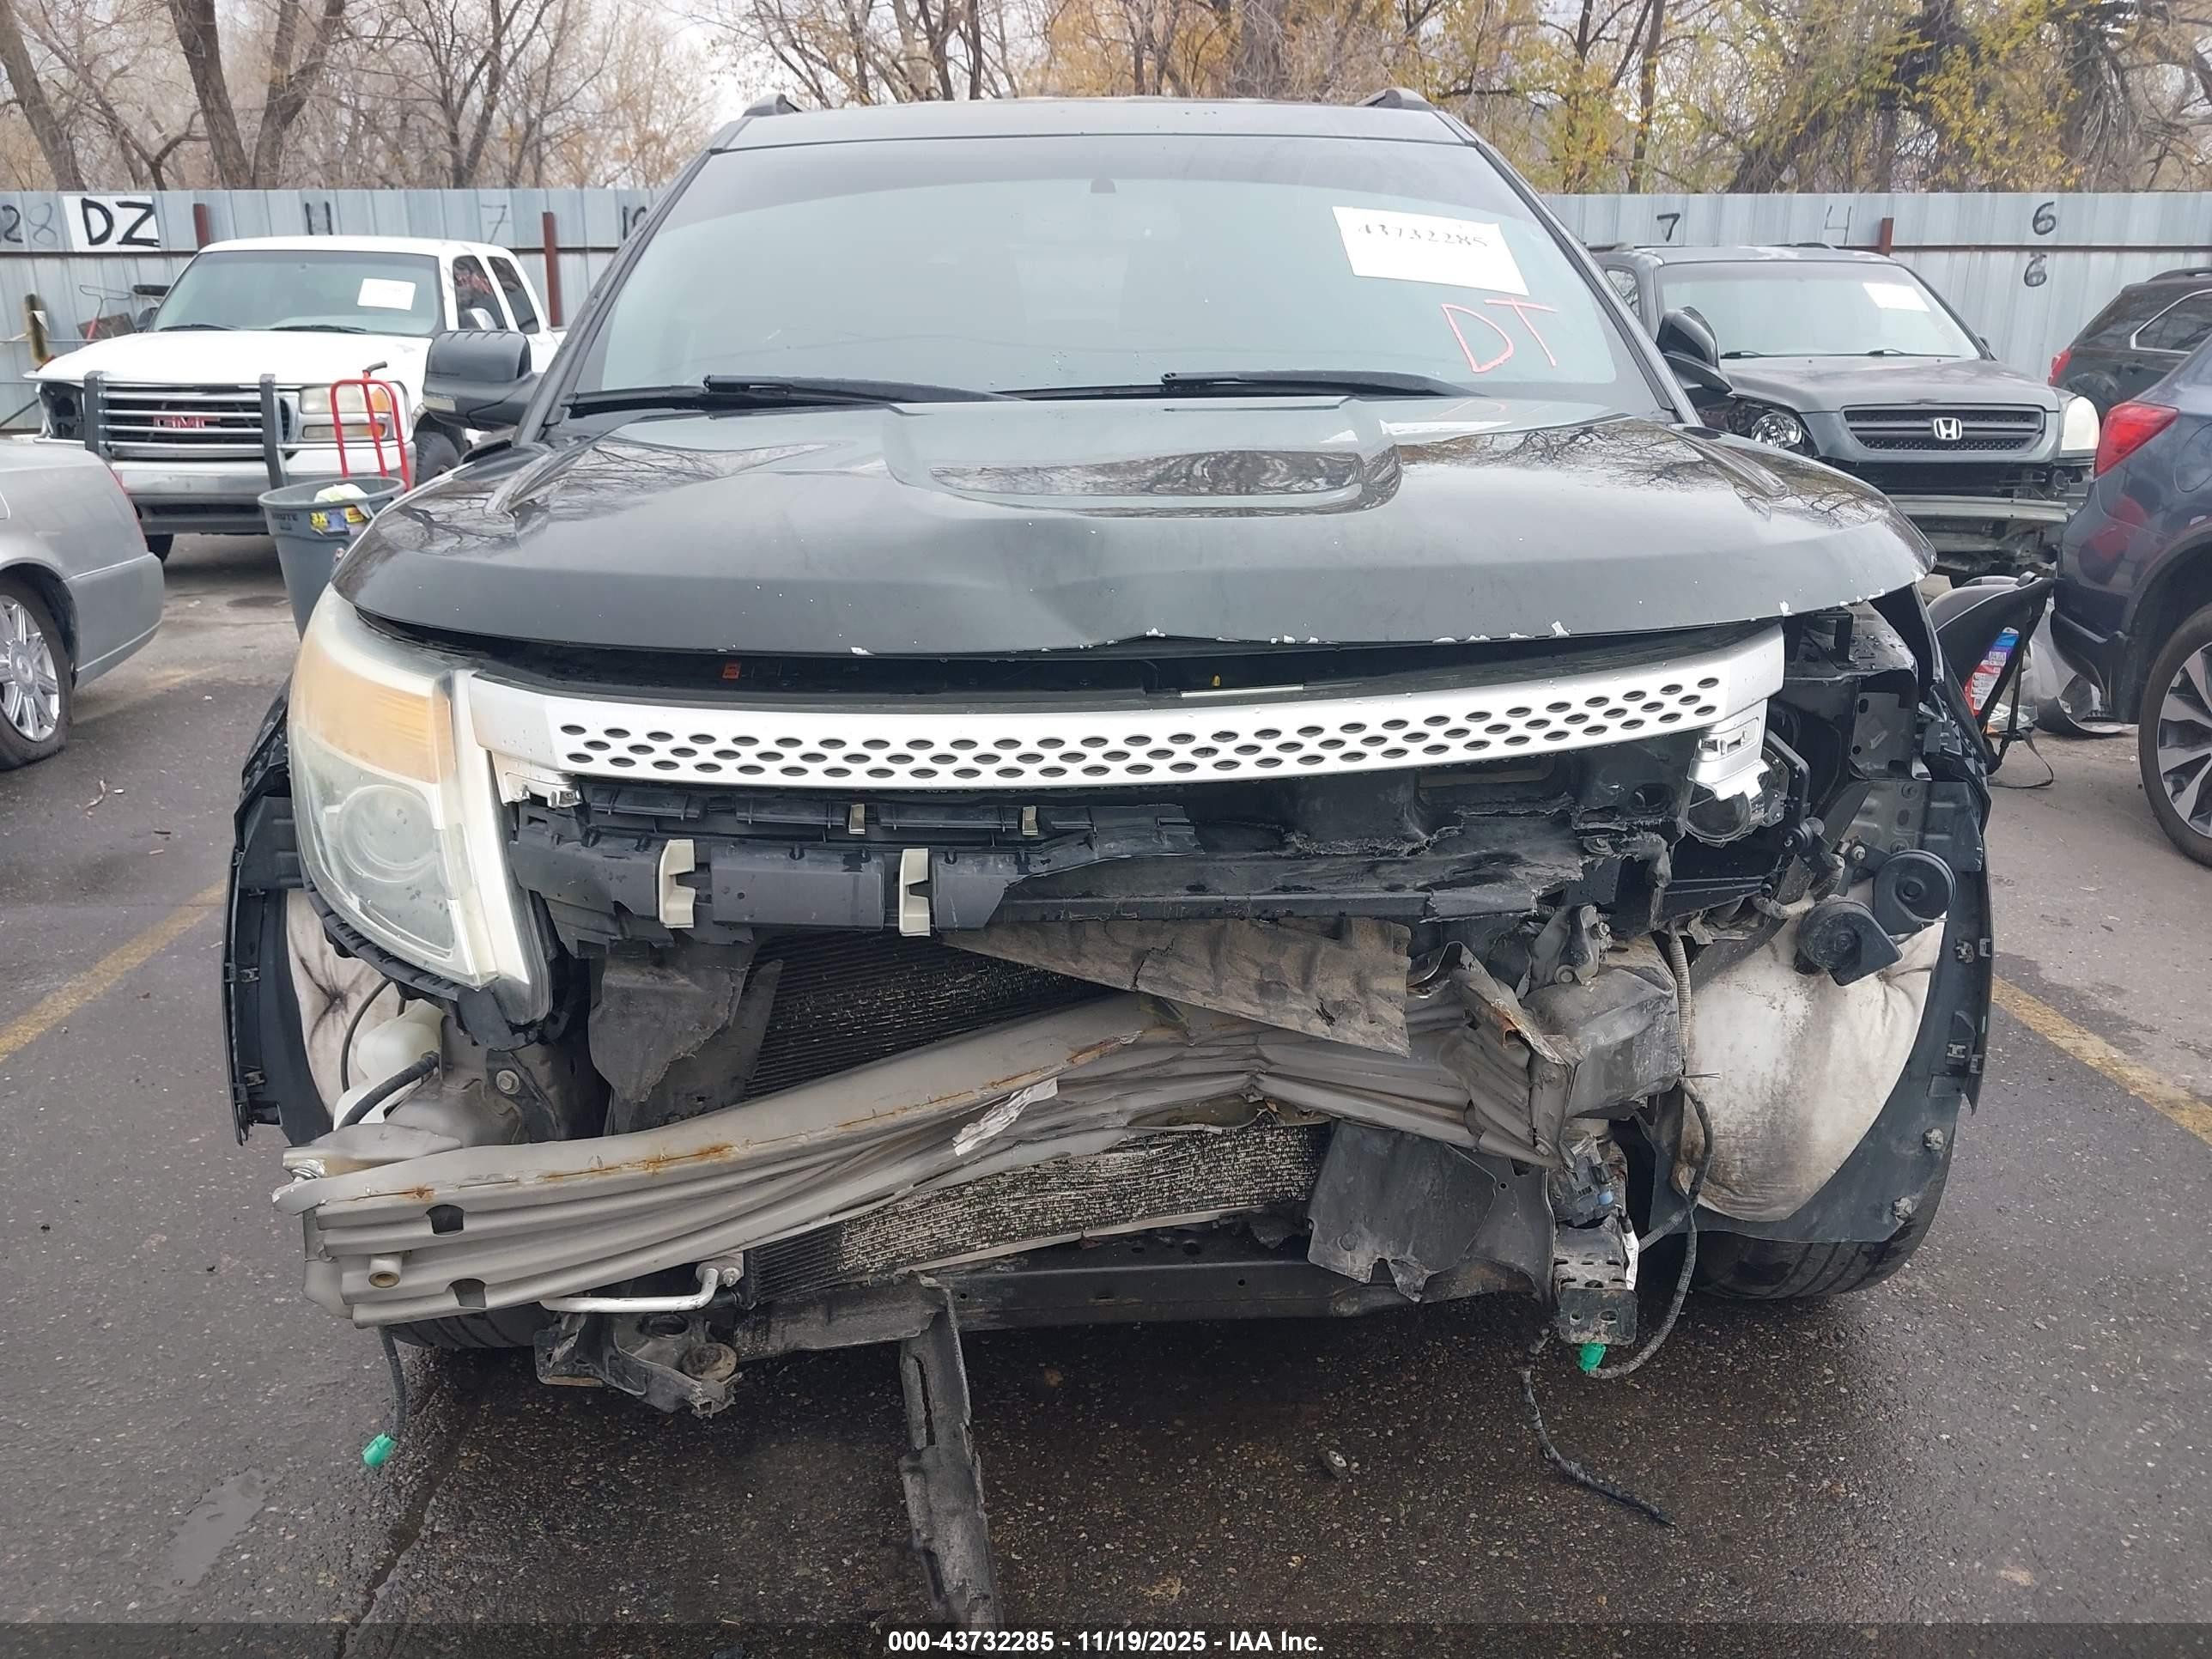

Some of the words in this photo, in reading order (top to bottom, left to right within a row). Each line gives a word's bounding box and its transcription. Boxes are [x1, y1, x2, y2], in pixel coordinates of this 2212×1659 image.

[81, 198, 161, 247] DZ
[1656, 213, 1680, 242] 7
[2033, 201, 2057, 235] 6
[1441, 297, 1559, 374] DT
